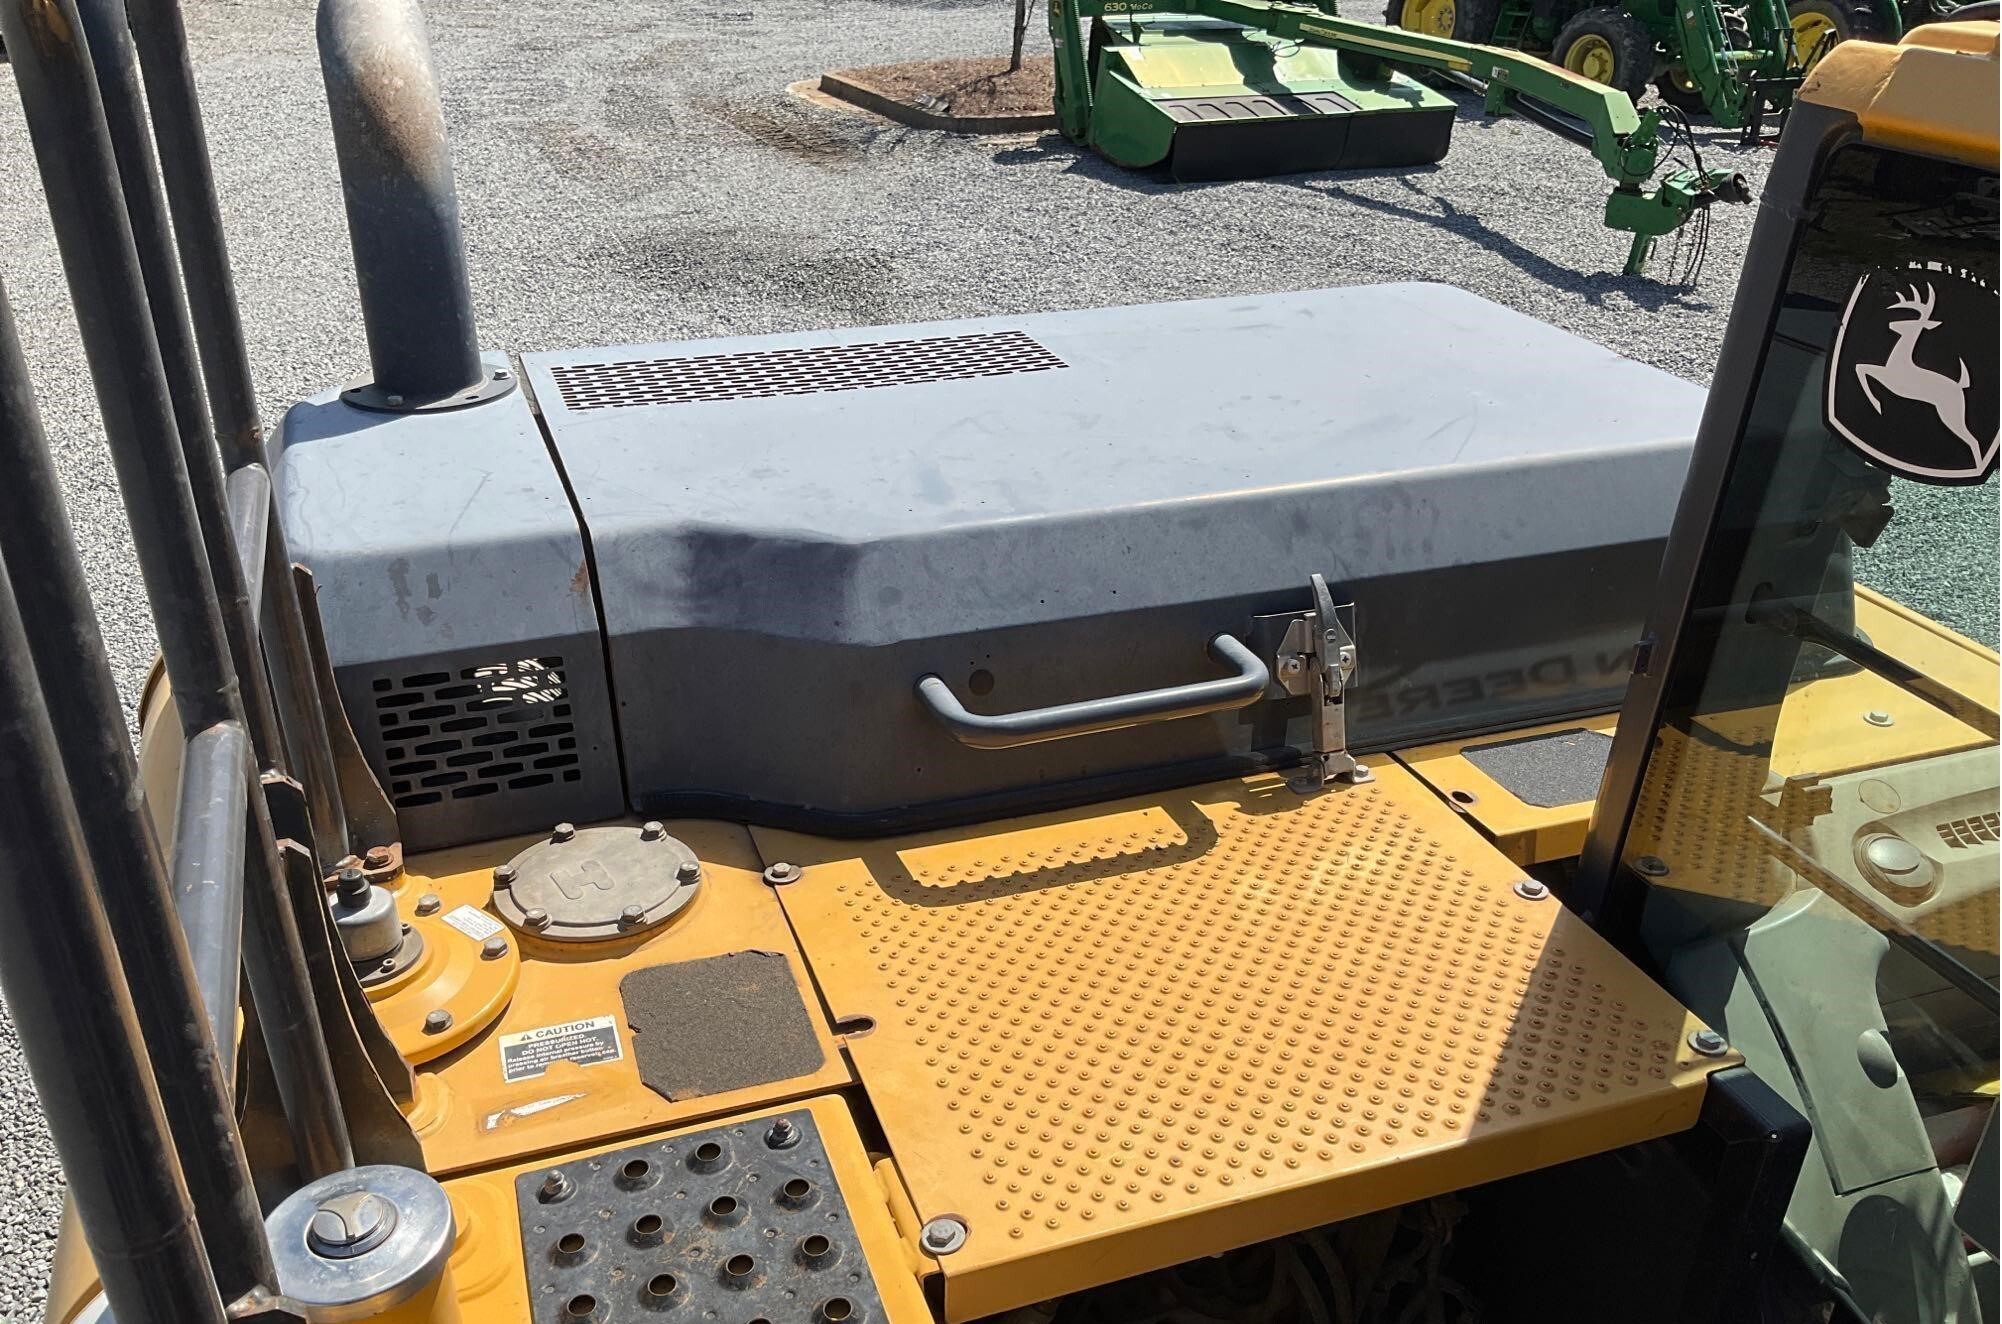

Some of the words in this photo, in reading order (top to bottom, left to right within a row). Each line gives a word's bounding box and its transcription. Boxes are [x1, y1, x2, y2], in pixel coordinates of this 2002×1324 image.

[1104, 2, 1127, 12] 630
[535, 1021, 595, 1038] CAUTION
[555, 1040, 578, 1048] OPEN
[507, 1054, 535, 1063] Release
[536, 1049, 562, 1058] internal
[563, 1043, 594, 1053] pressure
[507, 1059, 538, 1068] pressing
[550, 1050, 579, 1059] breather
[508, 1065, 525, 1073] prior
